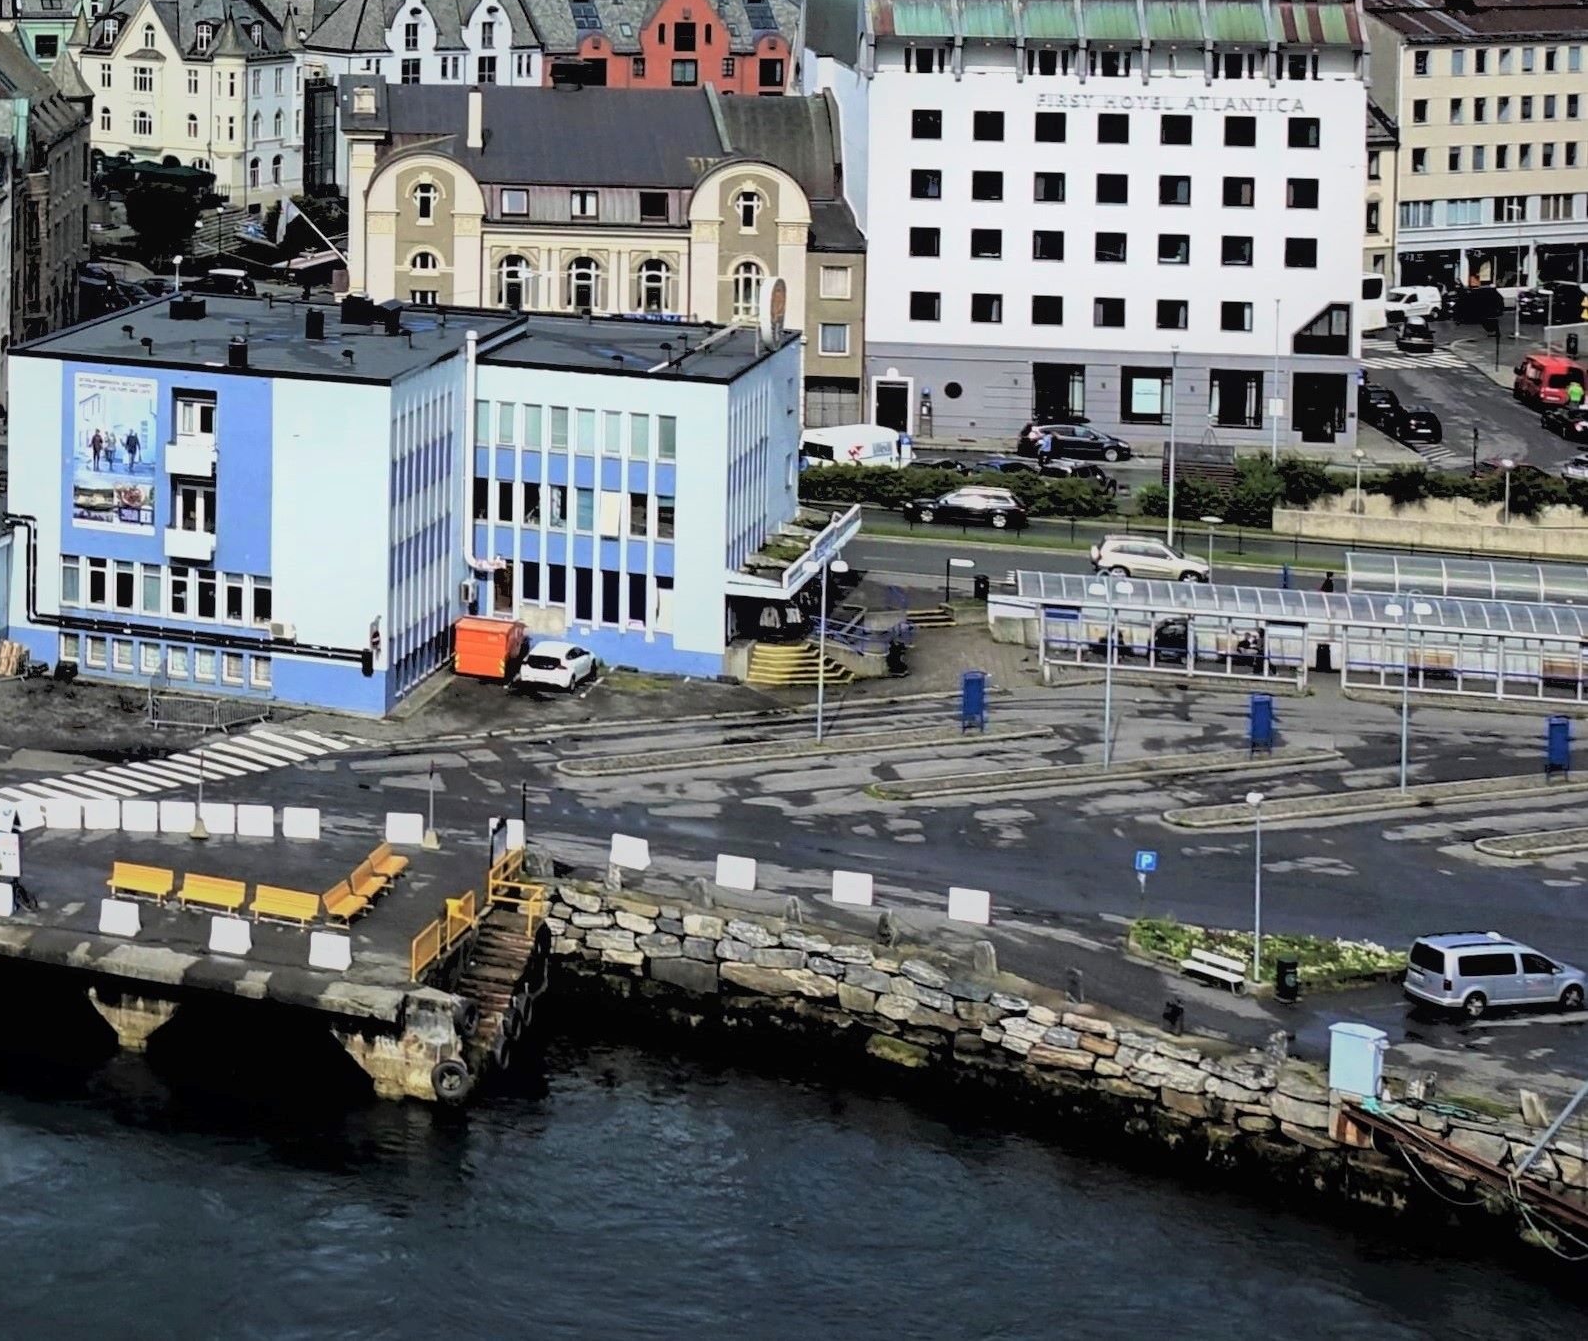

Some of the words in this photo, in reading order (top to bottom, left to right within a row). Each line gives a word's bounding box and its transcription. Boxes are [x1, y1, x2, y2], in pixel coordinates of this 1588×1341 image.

[1036, 93, 1094, 108] FIRST
[1104, 94, 1174, 110] HOTEL
[1185, 96, 1305, 113] ATLANTICA
[1141, 854, 1153, 868] P
